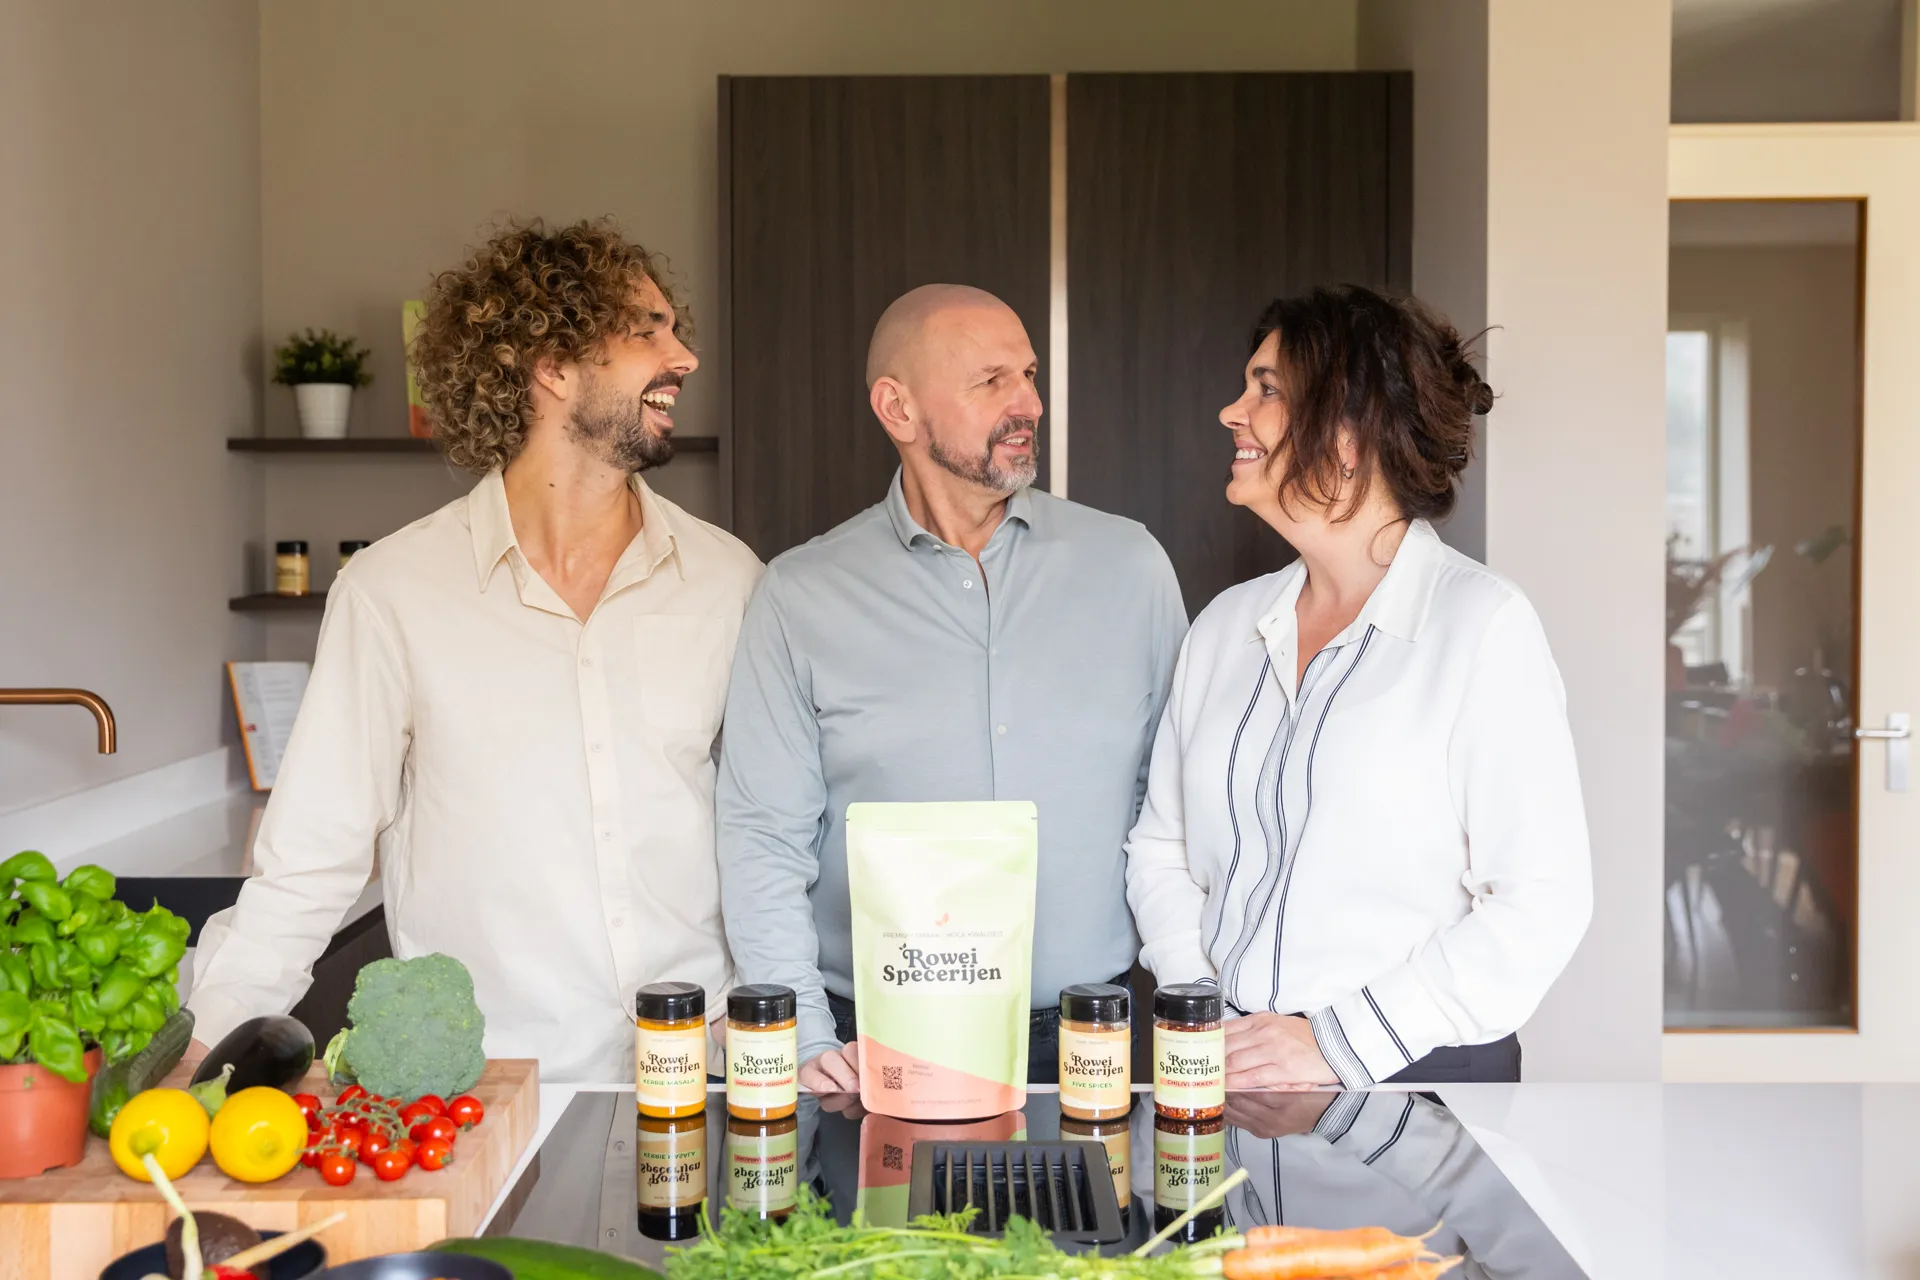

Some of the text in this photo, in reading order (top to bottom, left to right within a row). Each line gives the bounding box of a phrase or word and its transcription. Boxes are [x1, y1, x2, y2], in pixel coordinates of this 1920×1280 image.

[902, 947, 978, 970] Rowei
[882, 964, 1002, 986] Specerijen
[639, 1061, 701, 1073] Specerijen
[647, 1053, 689, 1067] Rowei
[742, 1053, 784, 1068] Rowei
[1071, 1053, 1113, 1067] Rowei
[1168, 1053, 1210, 1067] Rowei
[733, 1062, 794, 1075] Specerijen
[1063, 1061, 1124, 1076] Specerijen
[1159, 1061, 1220, 1076] Specerijen
[643, 1078, 696, 1086] KERRIE MASALA
[1072, 1080, 1113, 1089] FIVE SPICES
[1166, 1079, 1213, 1087] CHILIVLOKKEN
